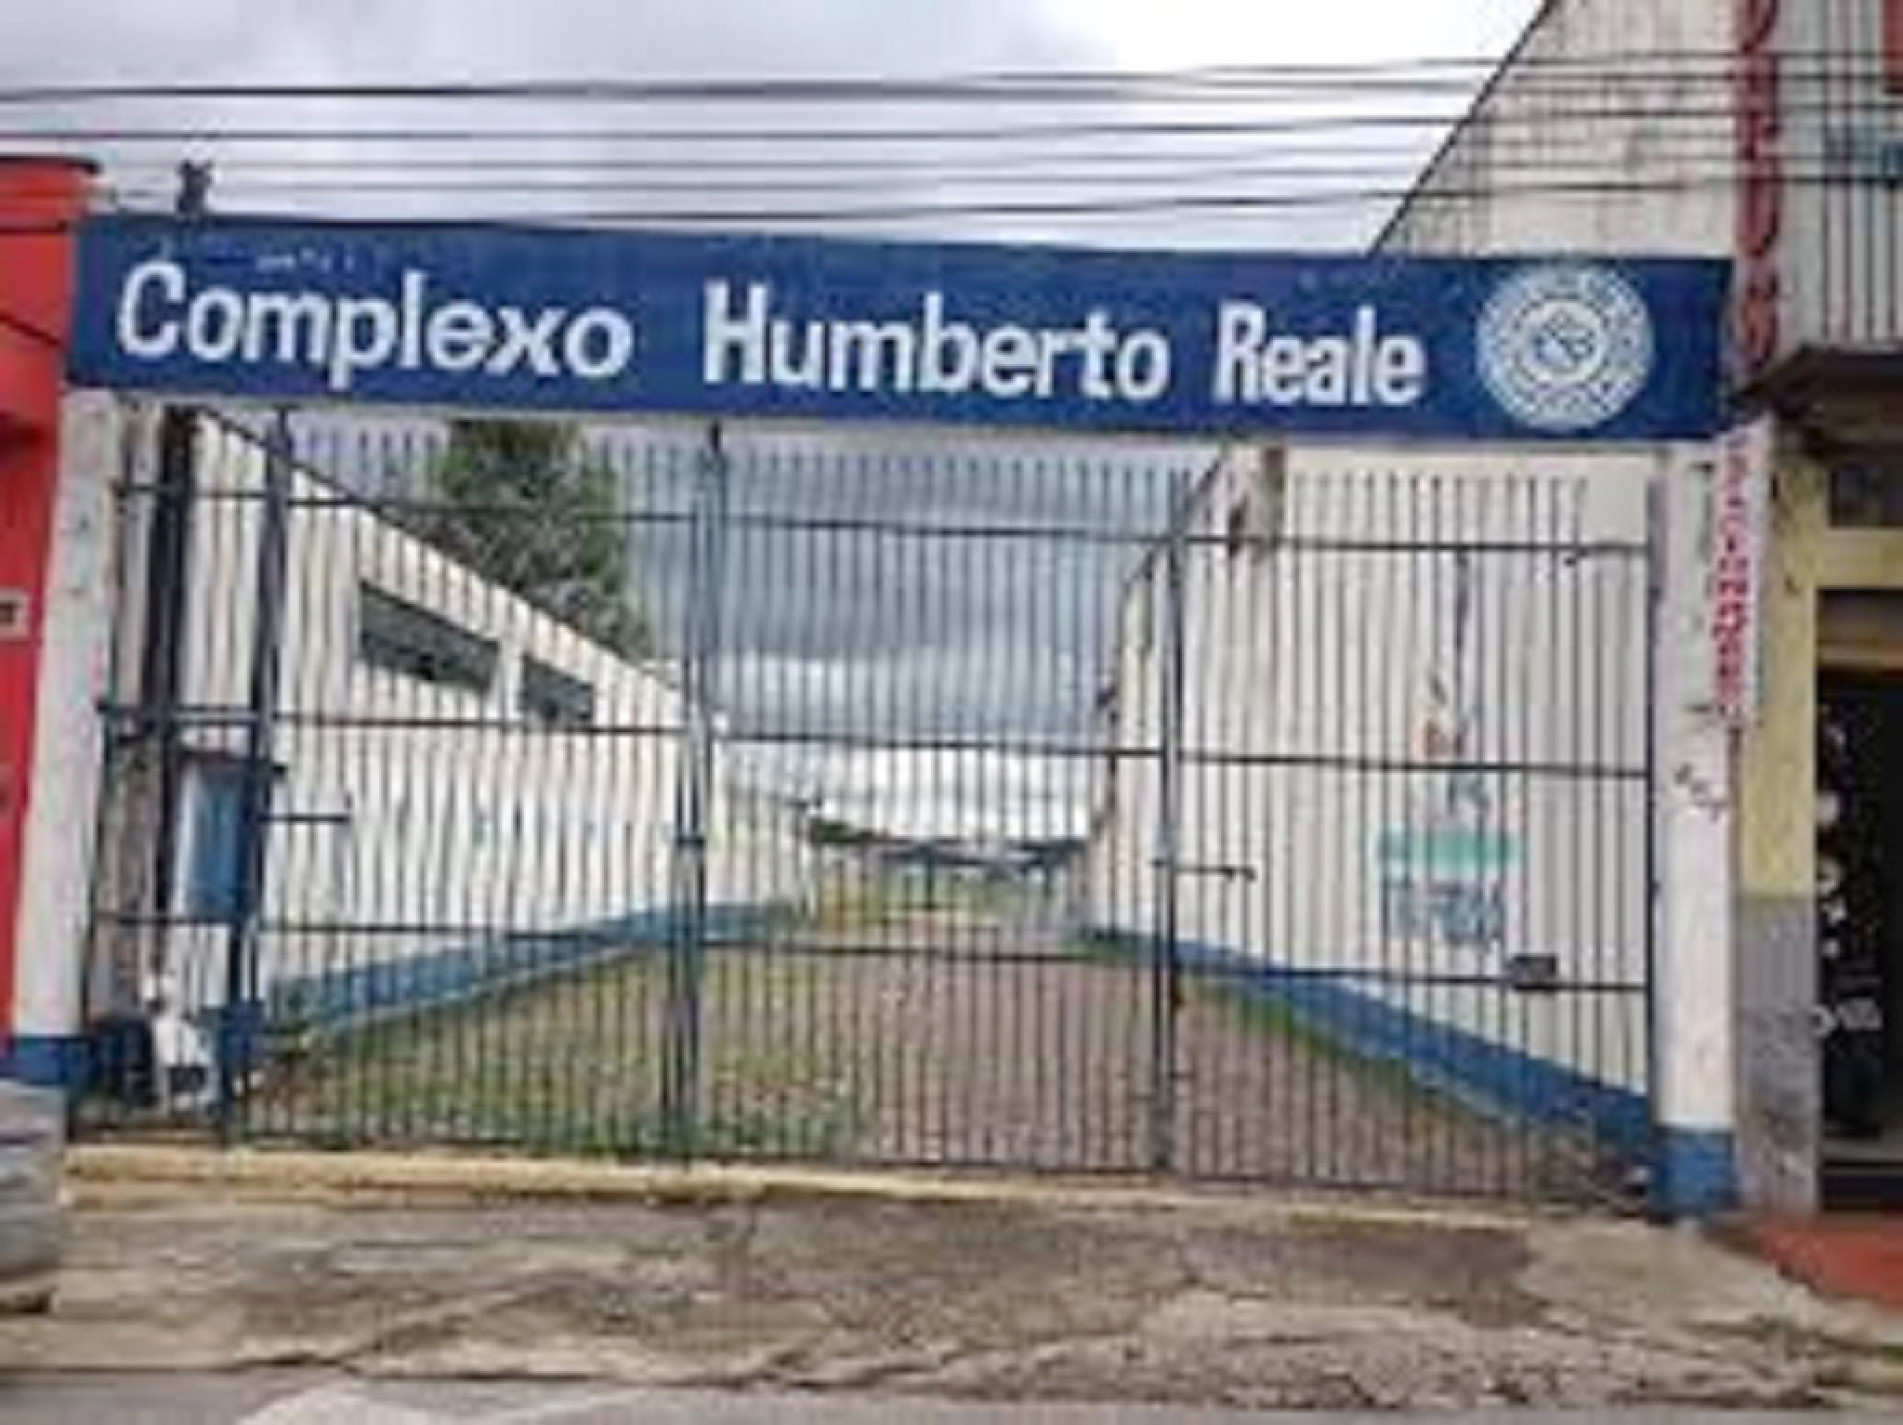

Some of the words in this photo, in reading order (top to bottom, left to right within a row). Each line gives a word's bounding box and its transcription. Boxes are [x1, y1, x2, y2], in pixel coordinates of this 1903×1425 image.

[117, 261, 634, 390] Complexo
[703, 281, 1170, 401] Humberto
[1213, 302, 1426, 406] Reale
